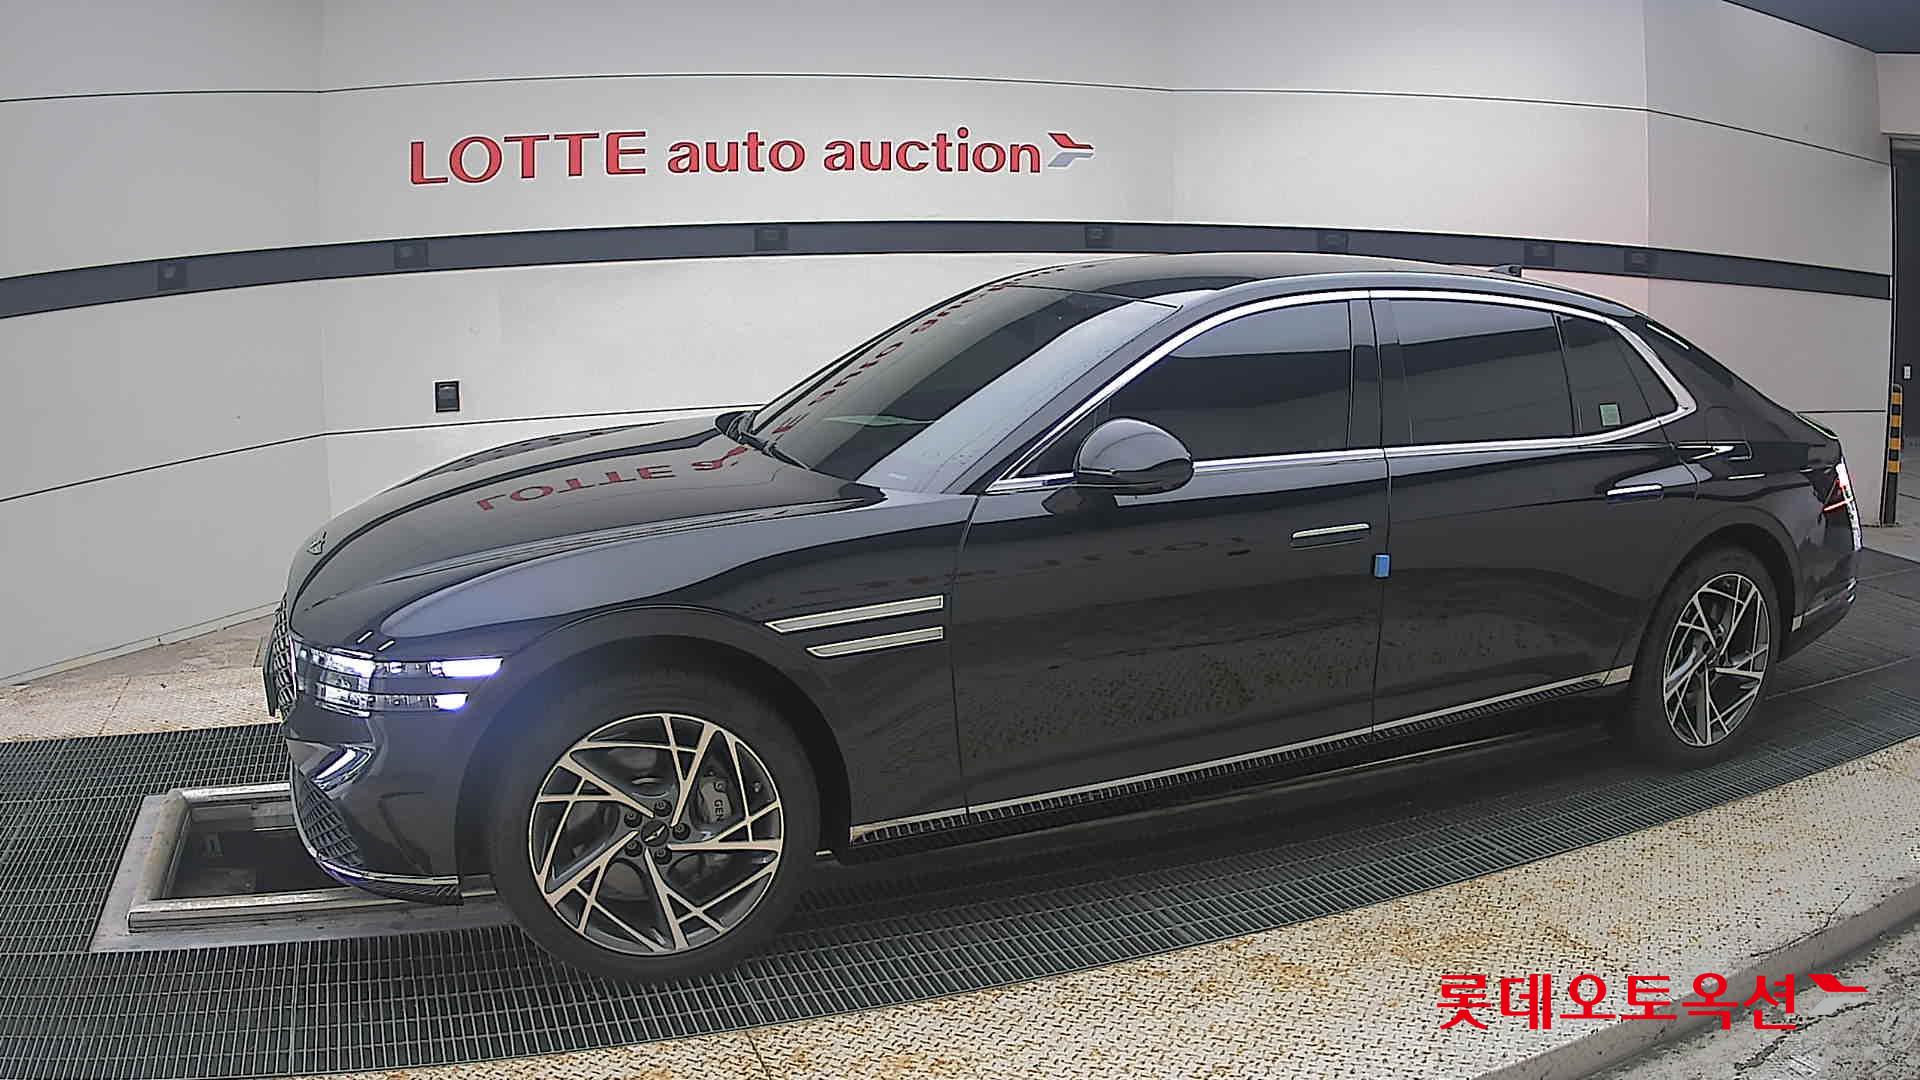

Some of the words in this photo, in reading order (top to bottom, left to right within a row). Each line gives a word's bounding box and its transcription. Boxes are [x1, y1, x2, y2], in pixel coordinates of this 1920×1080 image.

[409, 131, 645, 185] LOTTE
[667, 131, 806, 173] auto
[824, 127, 1042, 173] auction
